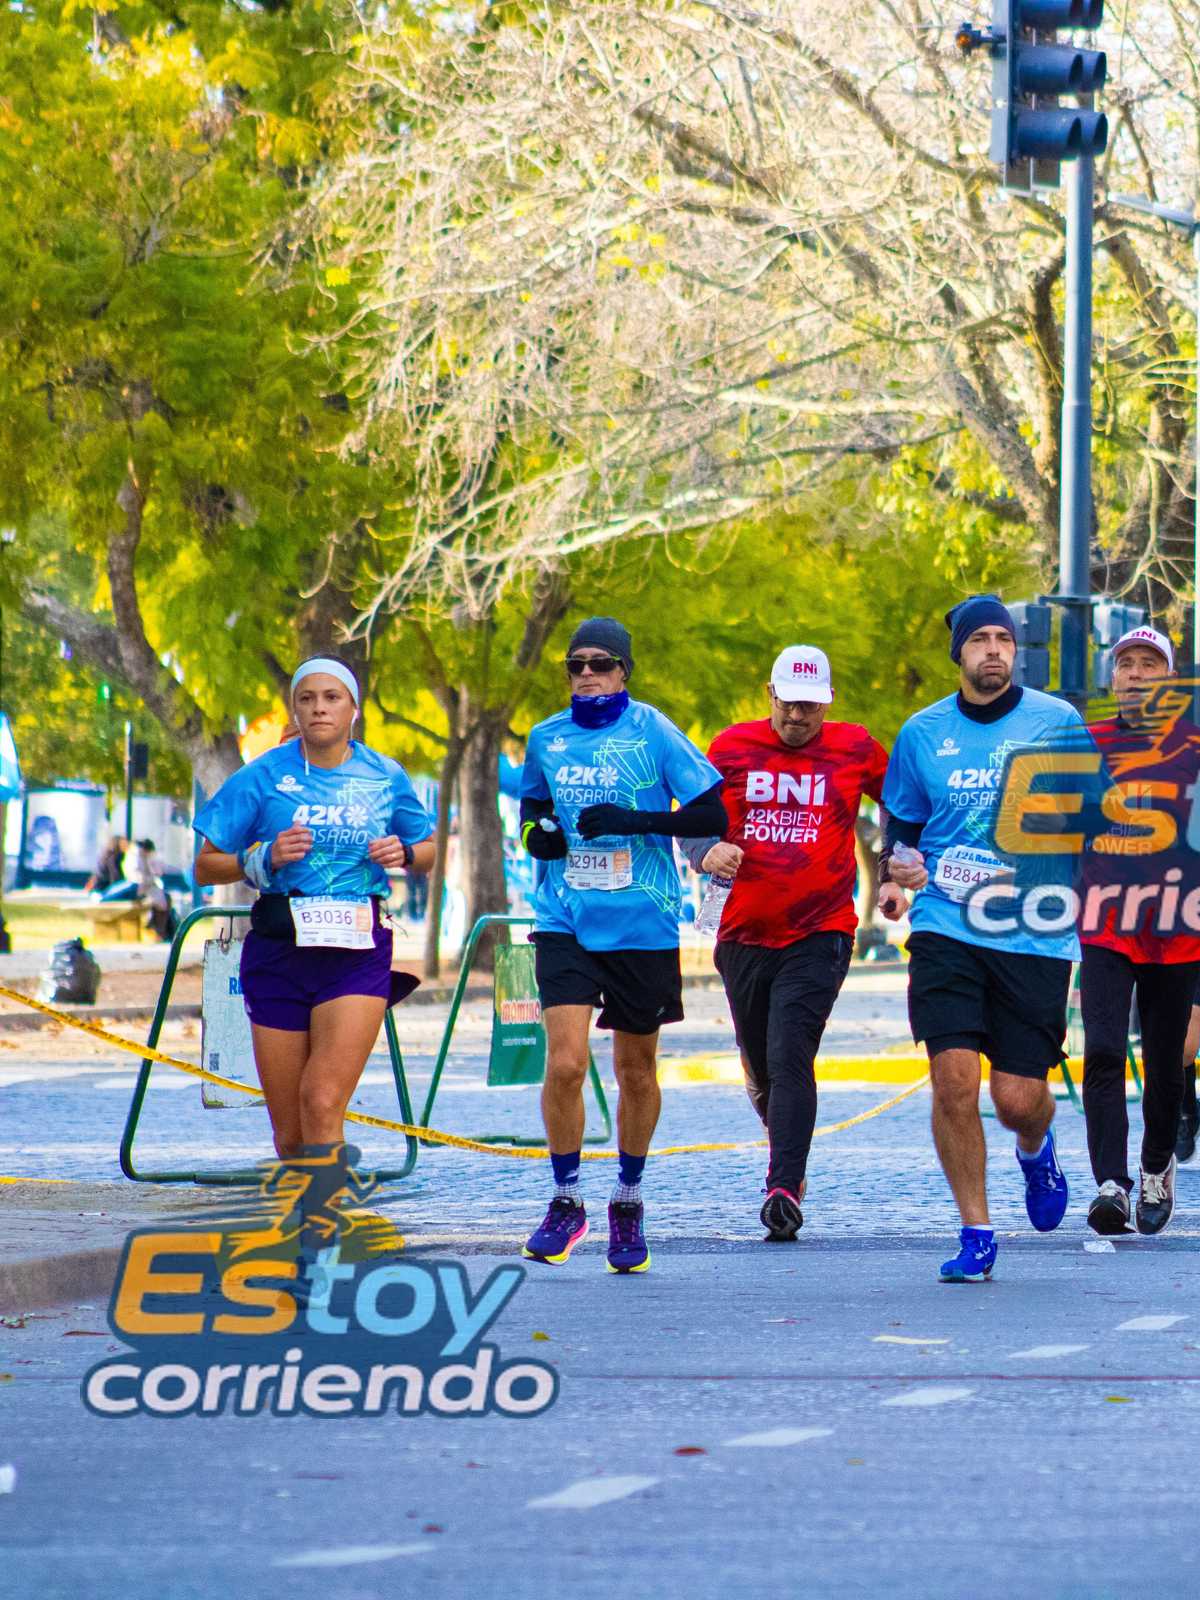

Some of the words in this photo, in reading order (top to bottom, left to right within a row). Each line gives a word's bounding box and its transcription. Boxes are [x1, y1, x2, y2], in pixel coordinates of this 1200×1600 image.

[555, 766, 600, 786] 42K
[947, 769, 996, 789] 42K
[556, 788, 618, 803] ROSARIO
[292, 805, 346, 826] 42K
[311, 828, 368, 845] OSARIO
[743, 824, 818, 843] POWER
[301, 910, 353, 925] B3036
